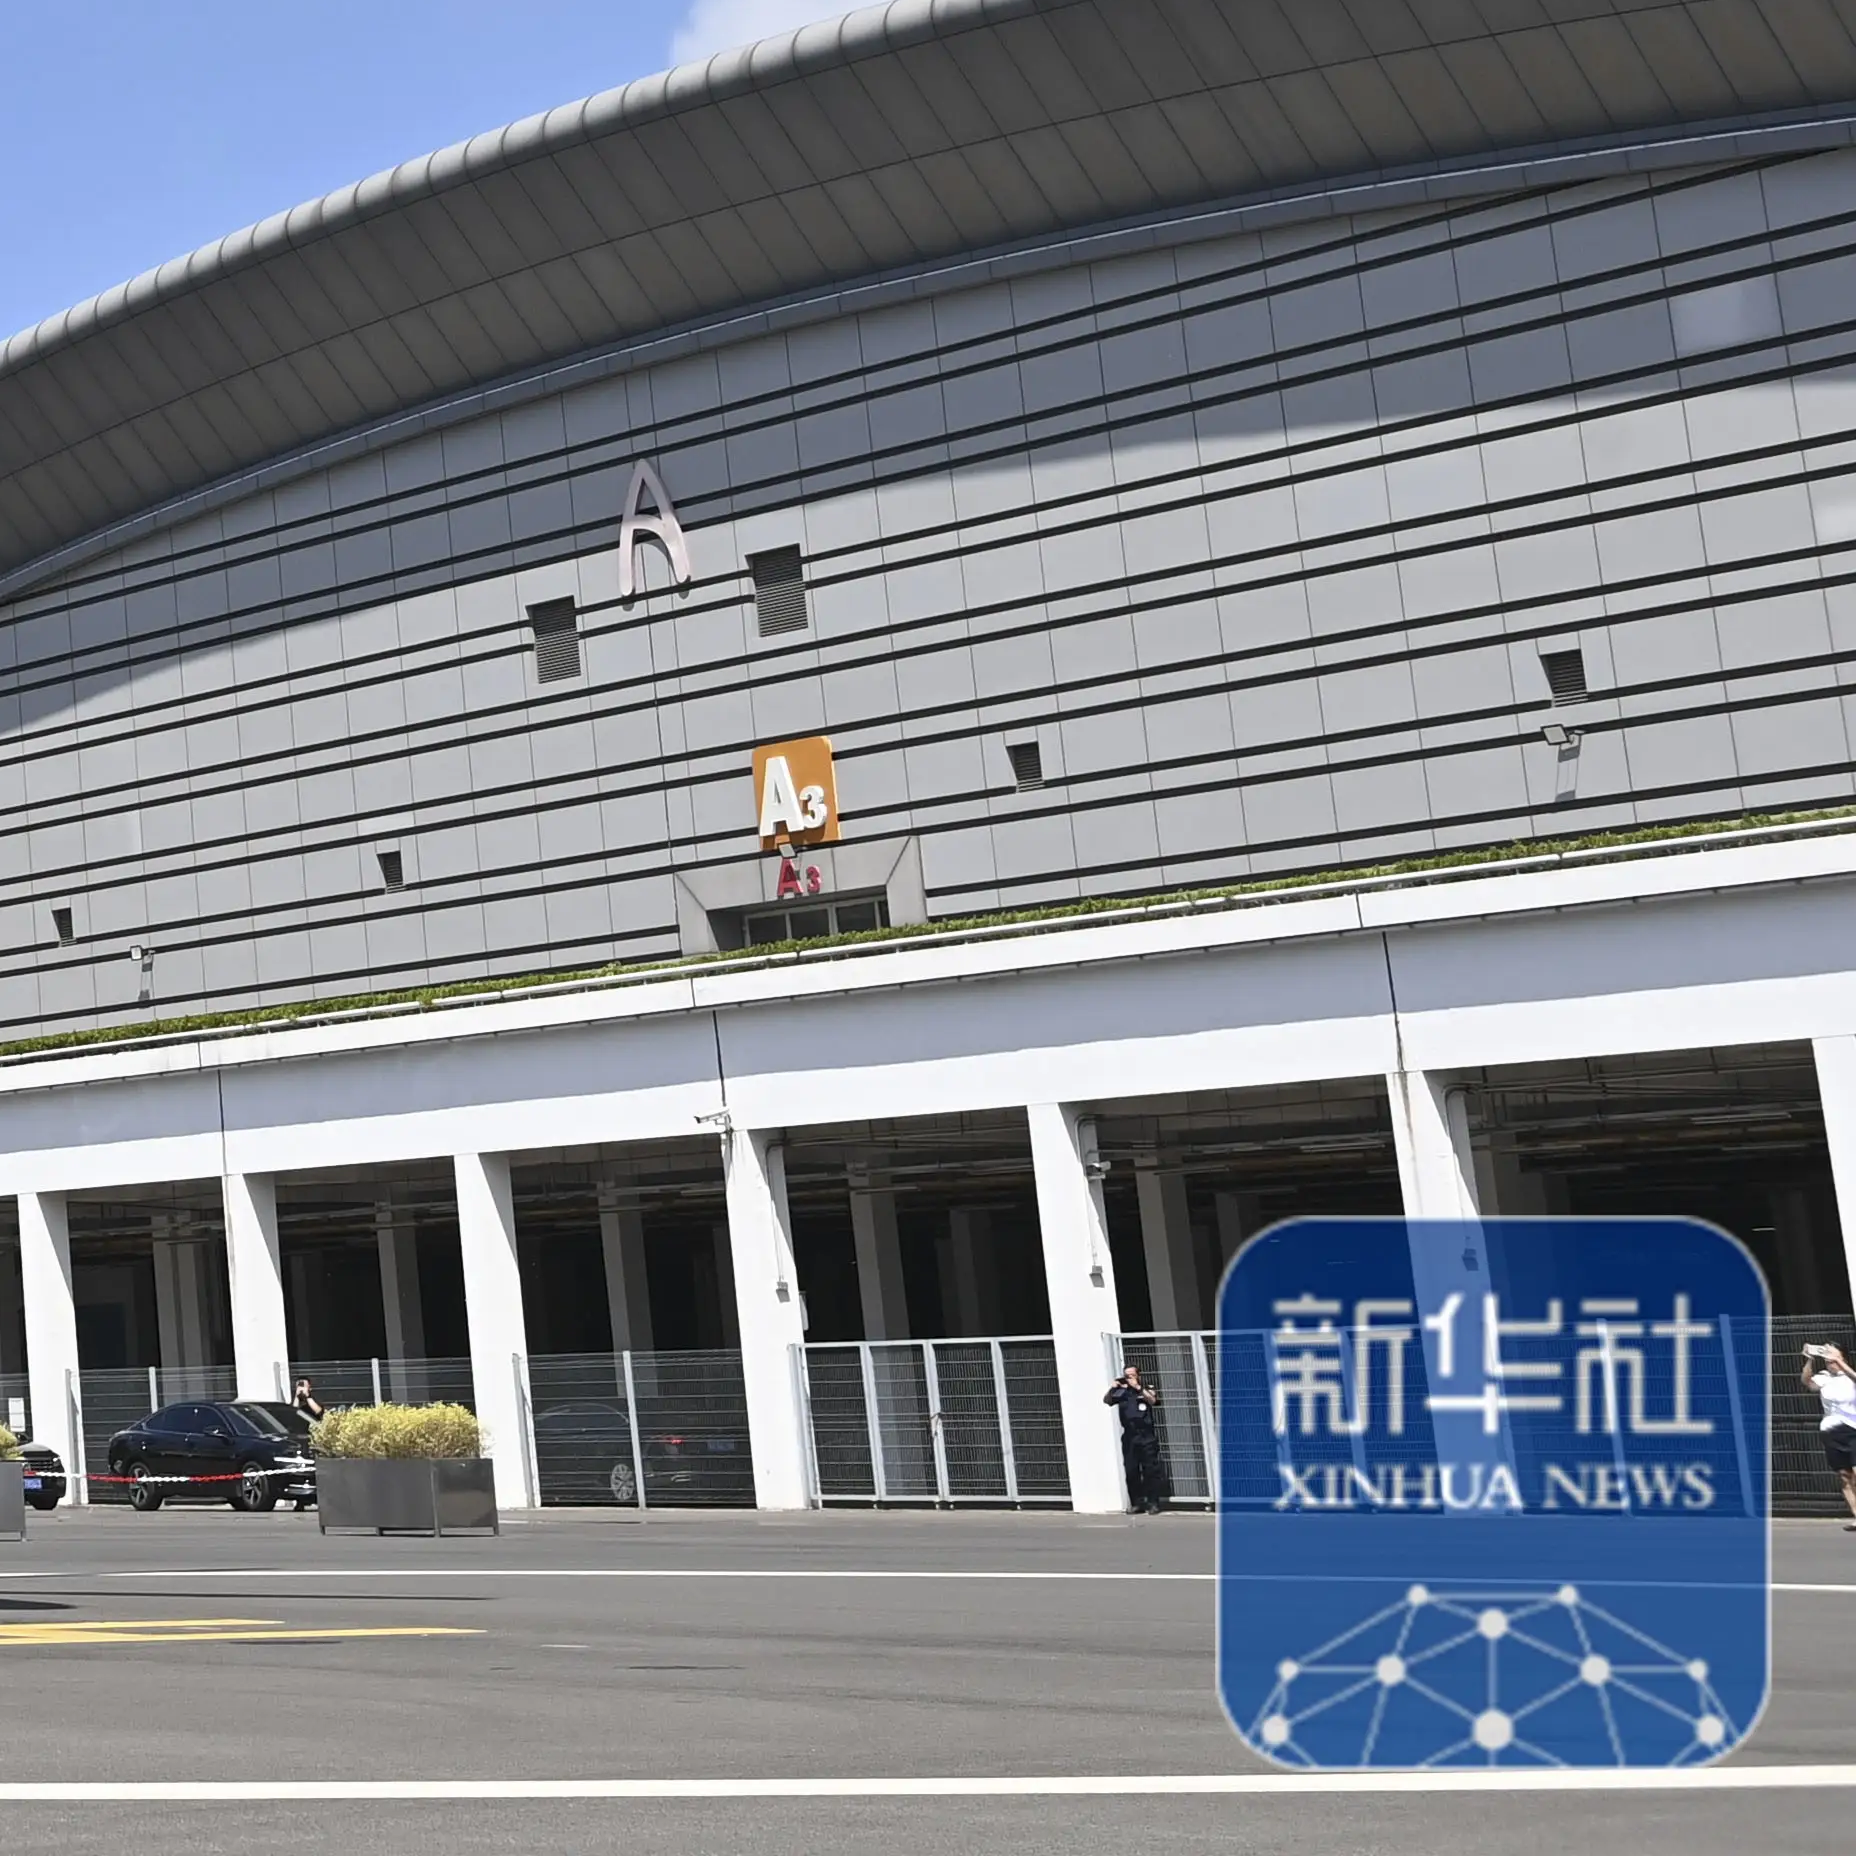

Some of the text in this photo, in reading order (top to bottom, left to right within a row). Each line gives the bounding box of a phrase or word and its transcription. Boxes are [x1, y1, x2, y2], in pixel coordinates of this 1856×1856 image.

[618, 459, 690, 597] A
[759, 755, 828, 837] A3
[776, 857, 822, 899] A3
